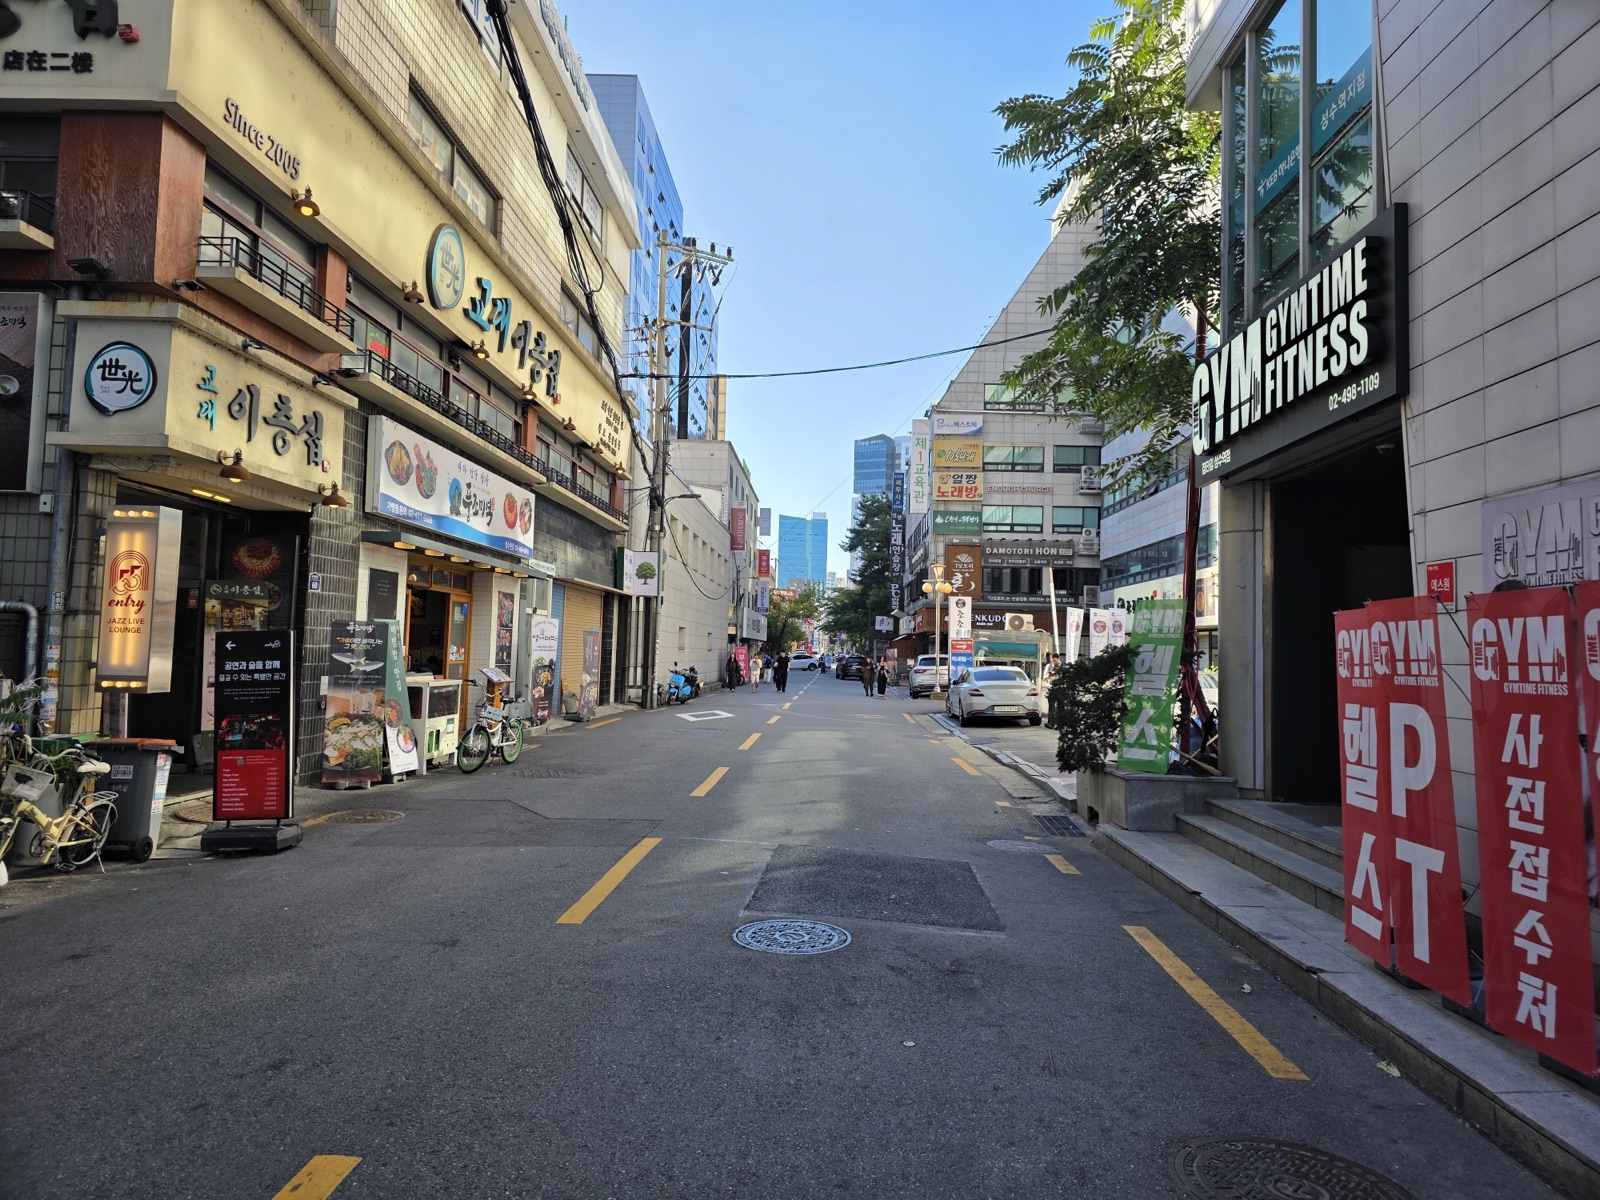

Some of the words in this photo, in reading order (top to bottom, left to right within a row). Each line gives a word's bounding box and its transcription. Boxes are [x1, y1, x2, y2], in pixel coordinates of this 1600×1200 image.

[3, 50, 94, 73] 店在二楼
[1320, 68, 1365, 131] 성수역지점
[223, 98, 264, 150] Since
[265, 138, 301, 180] 2005
[440, 241, 459, 296] 世光
[1265, 236, 1368, 357] GYMTIME
[97, 357, 144, 396] 世光
[1265, 300, 1369, 415] FITNESS
[1192, 318, 1262, 456] GYM
[1329, 371, 1380, 412] 02-498-1109
[228, 384, 324, 467] 이층집
[913, 436, 927, 504] 제1교육관
[952, 474, 977, 484] 얼짱
[987, 485, 1019, 493] ENOUGH
[1019, 486, 1052, 494] CHURCH
[936, 486, 978, 498] 노래방
[891, 519, 902, 572] 노래연습장
[986, 547, 1033, 555] DAMOTORI
[1035, 547, 1057, 555] HON
[108, 594, 146, 614] entry
[1431, 577, 1450, 591] 에스원
[1135, 608, 1184, 634] GYM
[1370, 620, 1438, 675] GYM
[1472, 615, 1568, 682] GYM
[1474, 641, 1483, 667] TIME
[1587, 634, 1599, 665] TIME
[232, 673, 238, 681] 수
[273, 672, 286, 680] 공간
[1394, 676, 1417, 686] GYMTIME
[1417, 676, 1438, 687] FITNESS
[1504, 682, 1537, 695] GYMTIME
[1537, 683, 1568, 696] FITNESS
[1122, 643, 1175, 760] 헬스
[1343, 703, 1383, 941] 헬스
[1502, 713, 1558, 1039] 사전접수처
